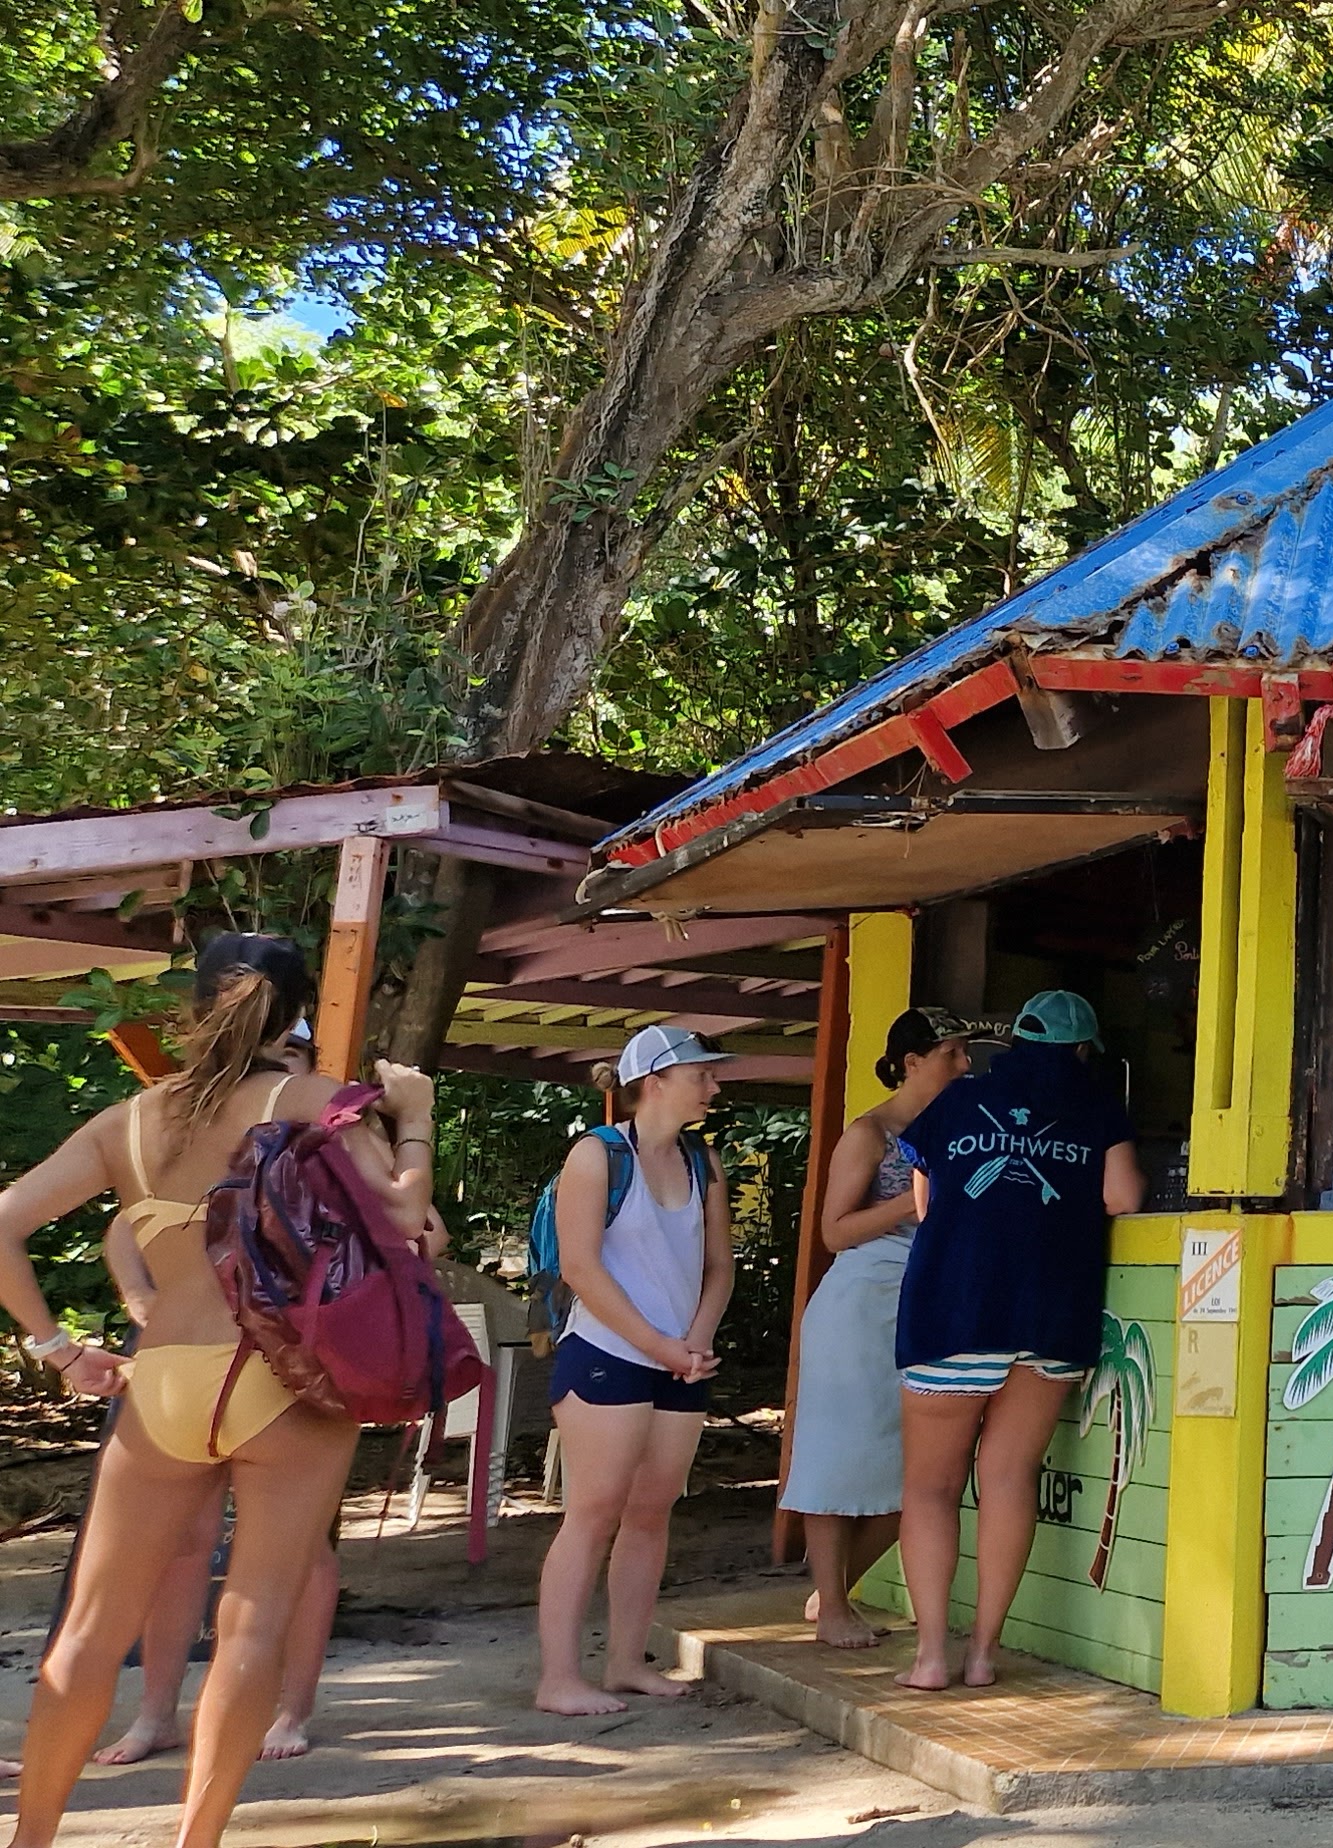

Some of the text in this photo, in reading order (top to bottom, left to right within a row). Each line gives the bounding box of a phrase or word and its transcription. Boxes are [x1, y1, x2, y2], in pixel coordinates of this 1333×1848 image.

[948, 1133, 1092, 1165] SOUTHWEST
[1192, 1241, 1207, 1256] III
[1184, 1238, 1240, 1312] LICENCE
[1188, 1329, 1199, 1354] R
